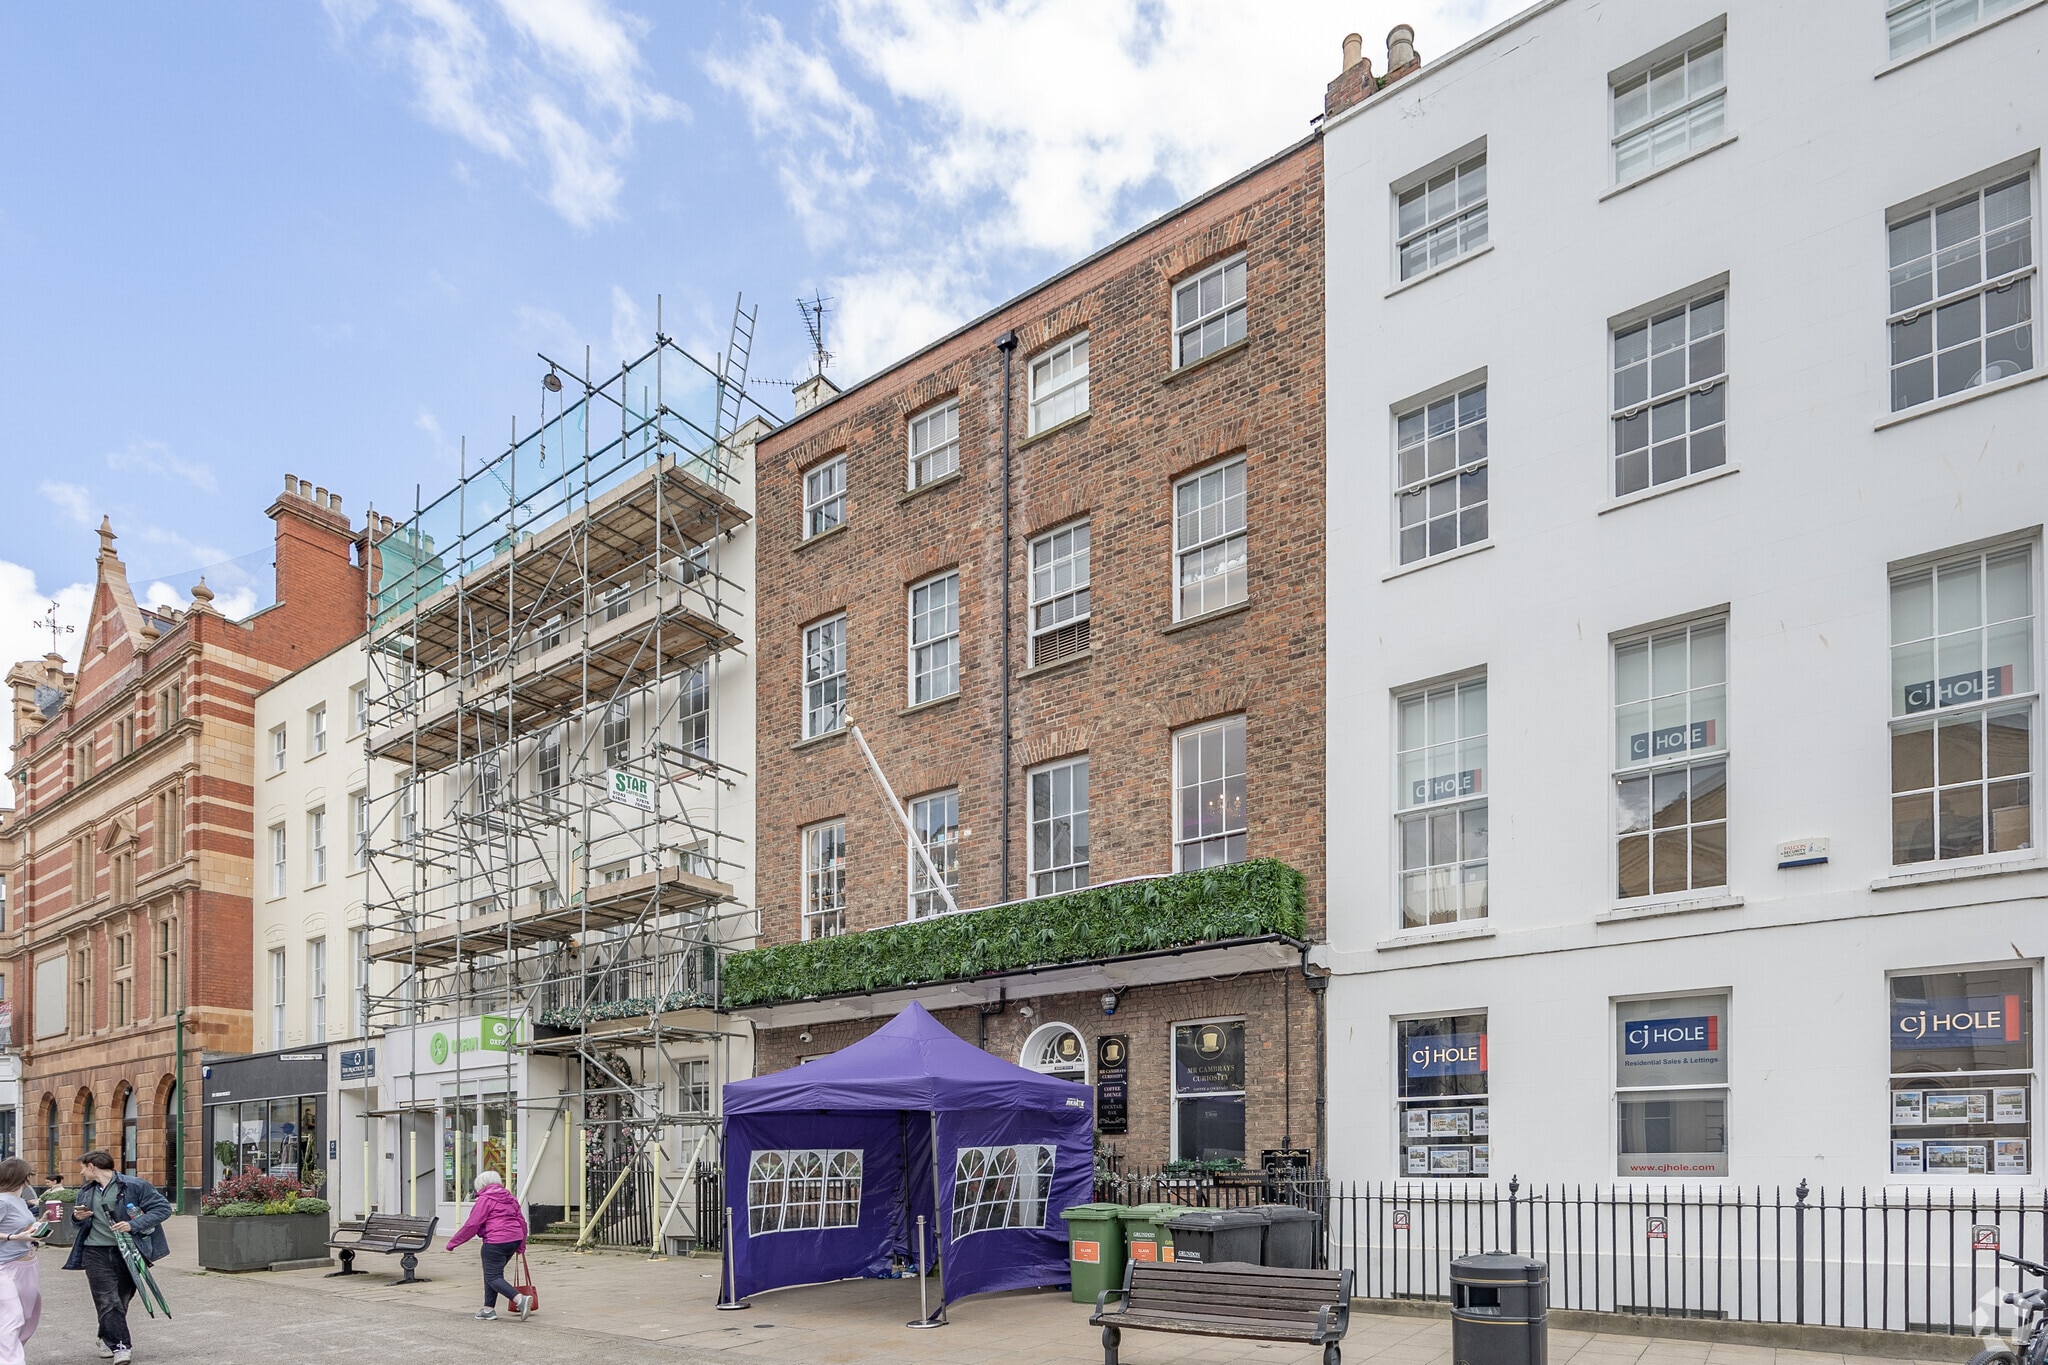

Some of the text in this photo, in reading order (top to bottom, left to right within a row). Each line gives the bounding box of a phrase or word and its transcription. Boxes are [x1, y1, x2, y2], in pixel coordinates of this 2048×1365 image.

[1939, 675, 1995, 700] HOLE
[1656, 729, 1701, 749] HOLE
[615, 773, 647, 793] STAR
[1933, 1010, 2001, 1032] HOLE
[1654, 1026, 1704, 1042] HOLE
[451, 1037, 479, 1054] OFAM
[1433, 1046, 1478, 1063] HOLE
[1625, 1059, 1662, 1067] Residential
[1690, 1056, 1719, 1065] Lettings
[1198, 1064, 1235, 1074] CAMBRAYS
[1192, 1073, 1229, 1083] CURIOSITY
[1630, 1164, 1715, 1173] www.cjhole.com
